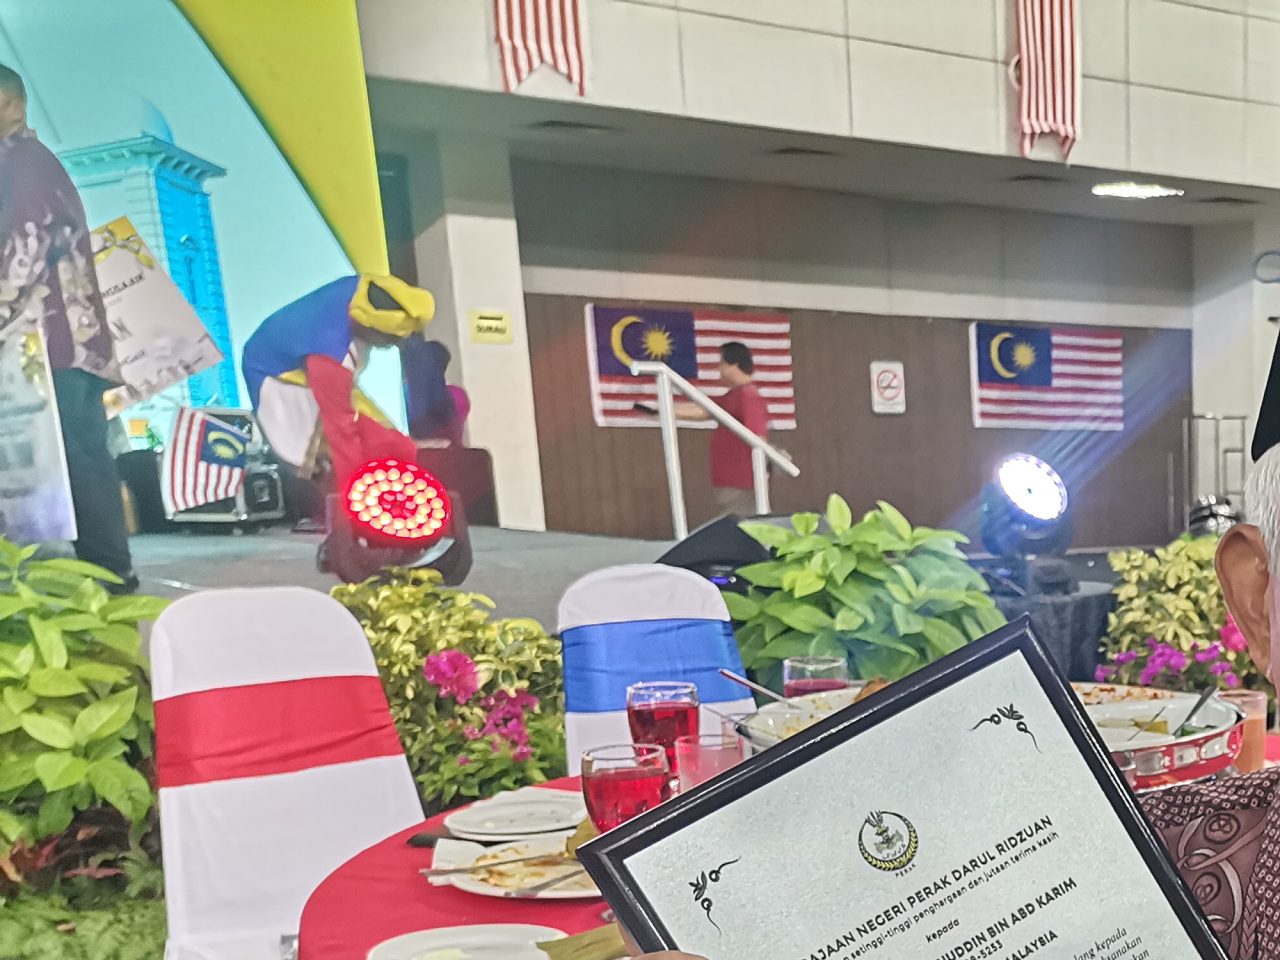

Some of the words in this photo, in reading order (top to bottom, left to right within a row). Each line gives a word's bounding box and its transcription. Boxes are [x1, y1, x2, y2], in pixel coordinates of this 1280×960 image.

[850, 917, 912, 959] setinggi-tinggi
[912, 886, 967, 924] penghargaan
[967, 876, 984, 889] dan
[983, 860, 1010, 882] jutaan
[1009, 844, 1037, 864] terima
[1036, 831, 1059, 847] kasih
[855, 901, 907, 938] NEGERI
[906, 874, 952, 908] PERAK
[950, 850, 996, 881] DARUL
[994, 814, 1053, 855] RIDZUAN
[986, 917, 1010, 938] BIN
[1010, 902, 1035, 925] ABD
[1034, 876, 1077, 908] KARIM
[925, 918, 960, 943] kepada
[1094, 927, 1127, 952] kepada
